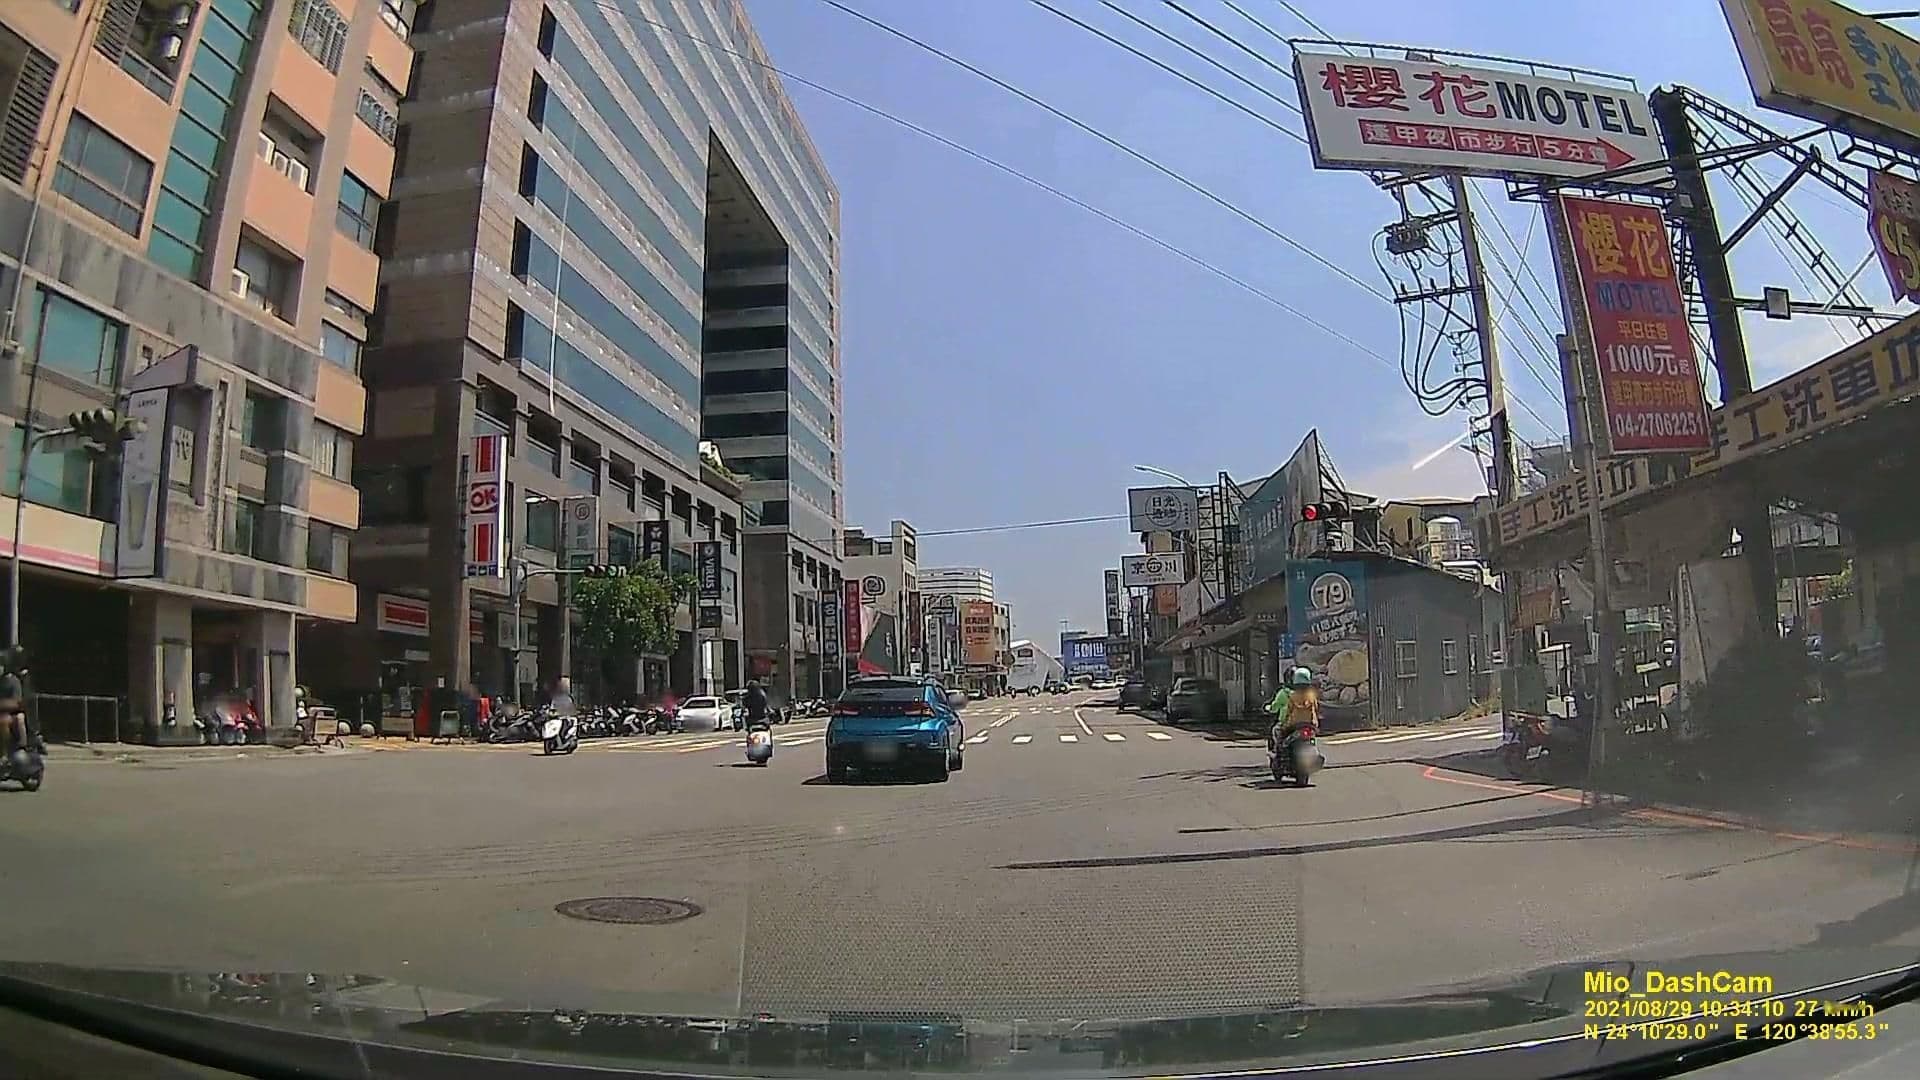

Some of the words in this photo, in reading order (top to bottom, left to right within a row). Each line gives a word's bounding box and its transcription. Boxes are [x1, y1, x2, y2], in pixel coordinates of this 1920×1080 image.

[1319, 62, 1497, 119] 櫻花
[1494, 81, 1647, 137] MOTEL
[1577, 210, 1668, 277] 櫻花
[1595, 281, 1679, 314] MOTEL
[1615, 411, 1705, 438] 04-27062251
[471, 487, 498, 508] OK
[1315, 582, 1345, 609] 79
